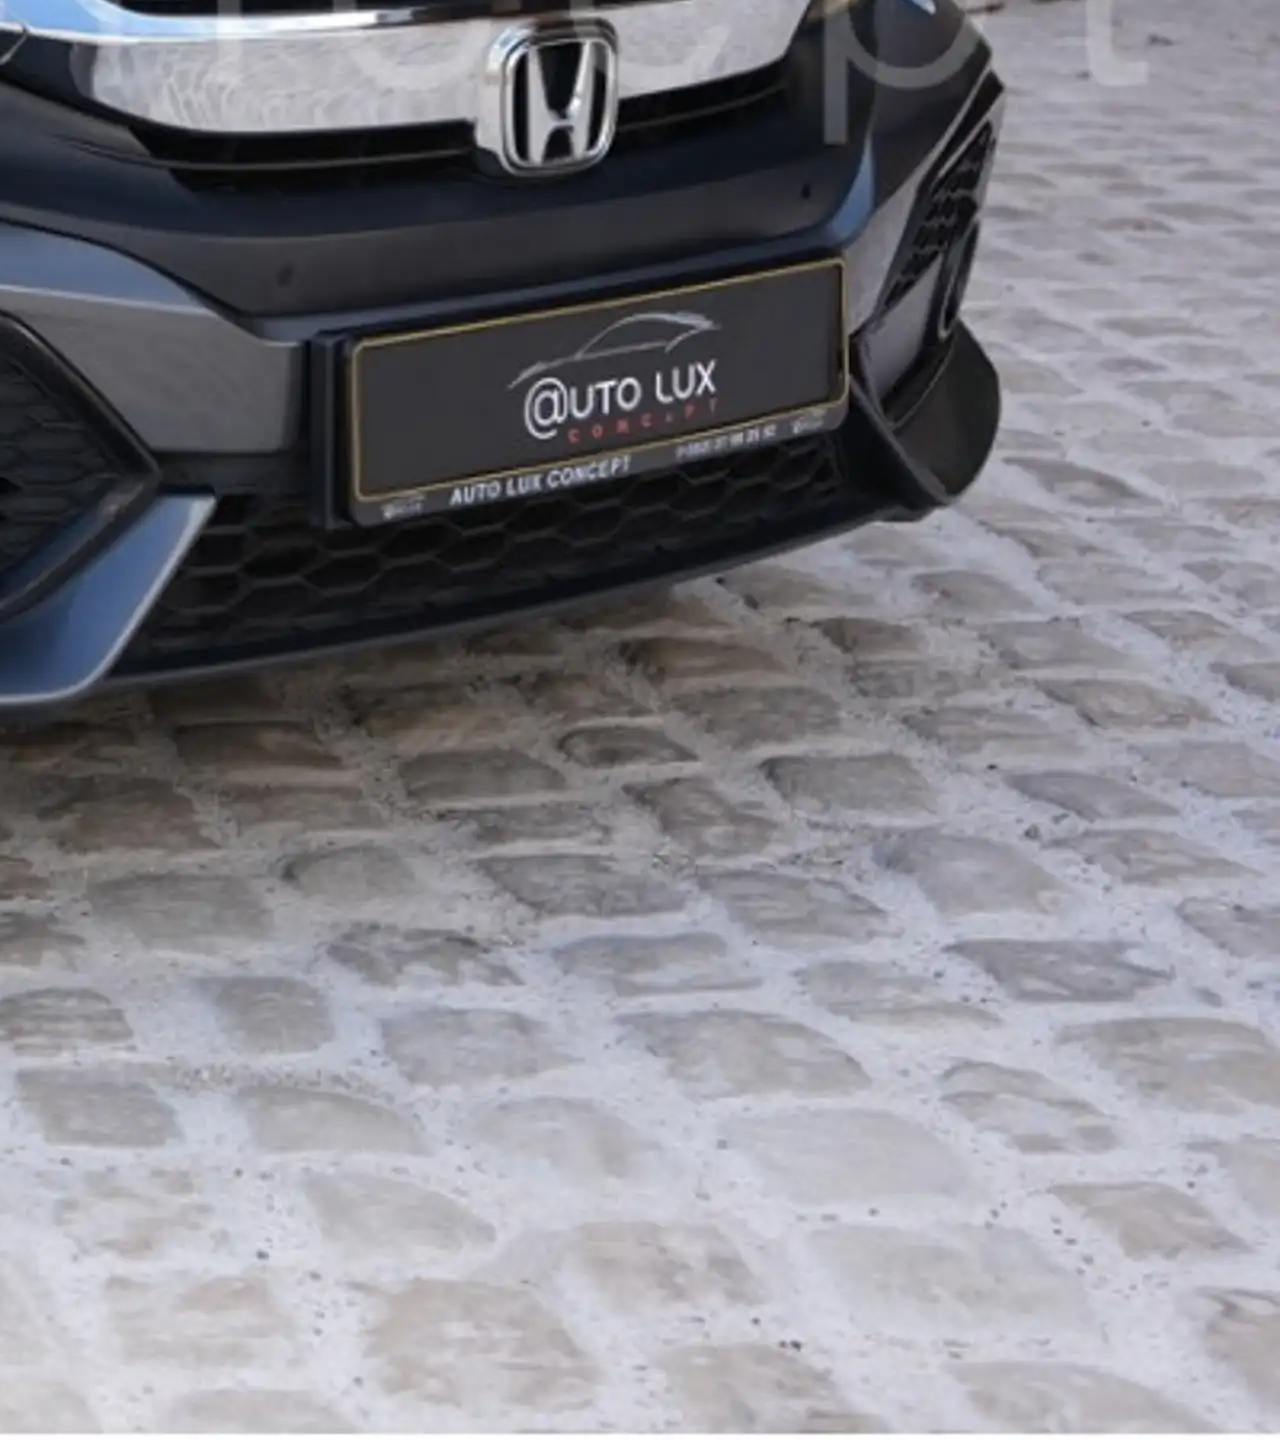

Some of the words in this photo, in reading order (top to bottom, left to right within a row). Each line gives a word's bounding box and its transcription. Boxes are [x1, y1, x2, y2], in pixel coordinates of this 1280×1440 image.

[654, 358, 718, 404] LUX
[449, 479, 502, 507] AUTO
[505, 472, 543, 498] LUX
[545, 454, 632, 490] CONCEPT
